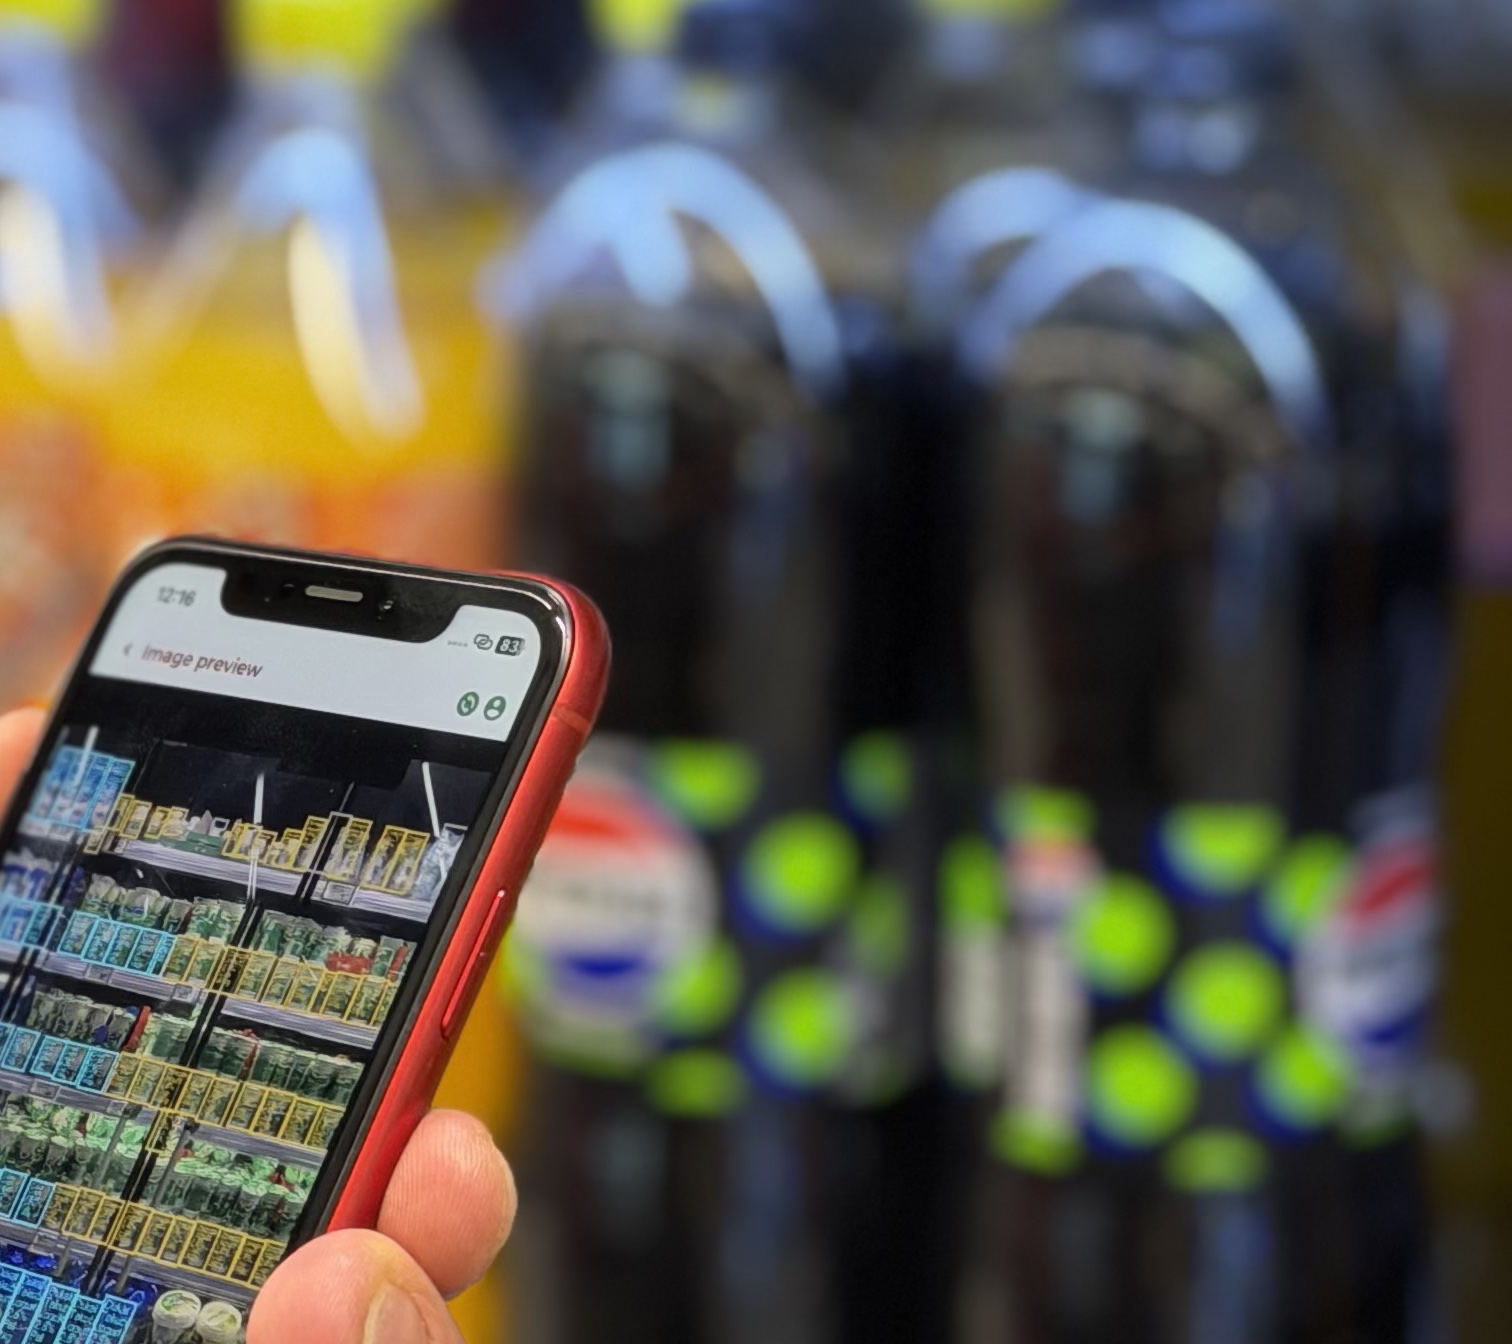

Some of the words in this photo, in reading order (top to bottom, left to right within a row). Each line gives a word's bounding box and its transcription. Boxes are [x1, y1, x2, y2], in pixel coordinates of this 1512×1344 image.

[157, 586, 196, 607] 12:16
[500, 638, 519, 653] 83
[142, 644, 194, 669] Image
[193, 656, 264, 677] preview
